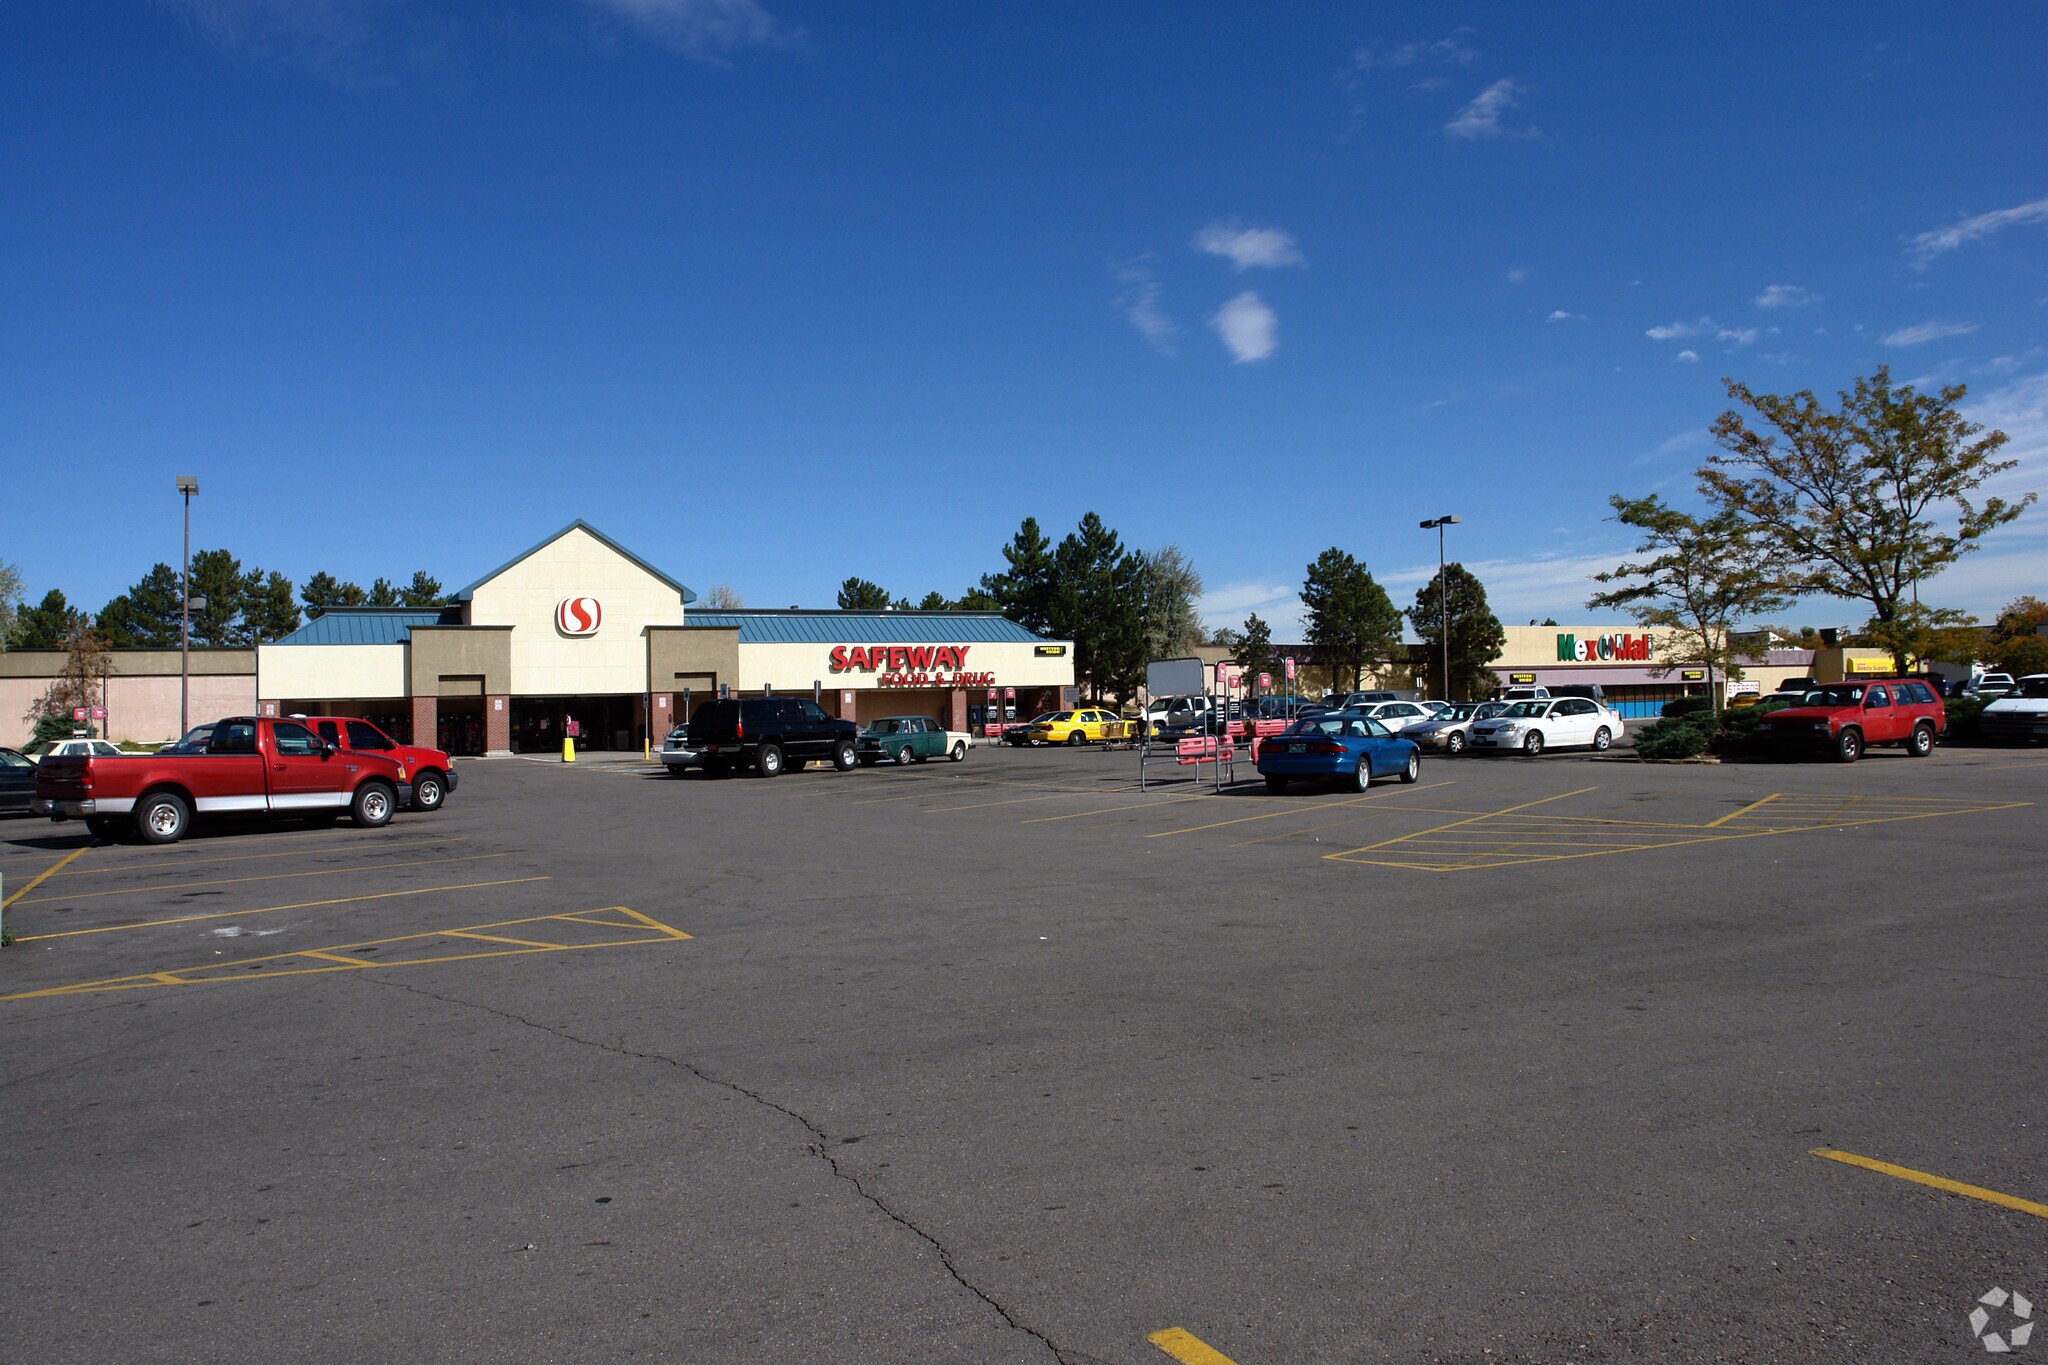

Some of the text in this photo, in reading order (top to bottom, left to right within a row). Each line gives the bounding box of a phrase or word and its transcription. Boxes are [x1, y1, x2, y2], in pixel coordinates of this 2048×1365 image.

[831, 645, 971, 671] SAFEWAY
[1557, 633, 1598, 661] Mex
[881, 671, 996, 687] FOOD & DRUG
